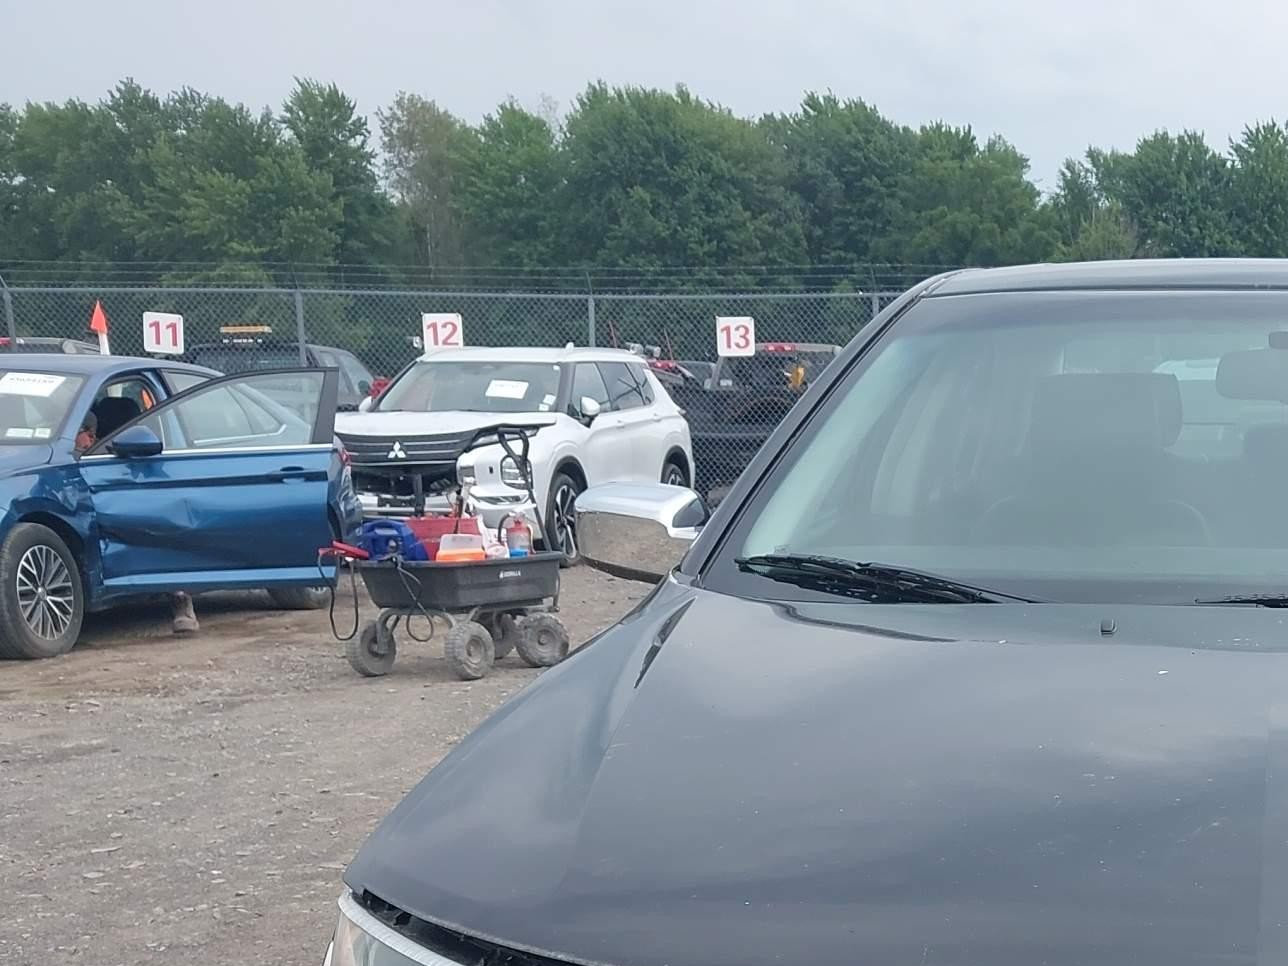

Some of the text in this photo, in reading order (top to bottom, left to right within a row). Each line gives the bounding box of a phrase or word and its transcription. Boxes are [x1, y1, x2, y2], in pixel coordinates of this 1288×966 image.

[148, 320, 178, 347] 11
[426, 321, 459, 346] 12
[720, 324, 750, 349] 13
